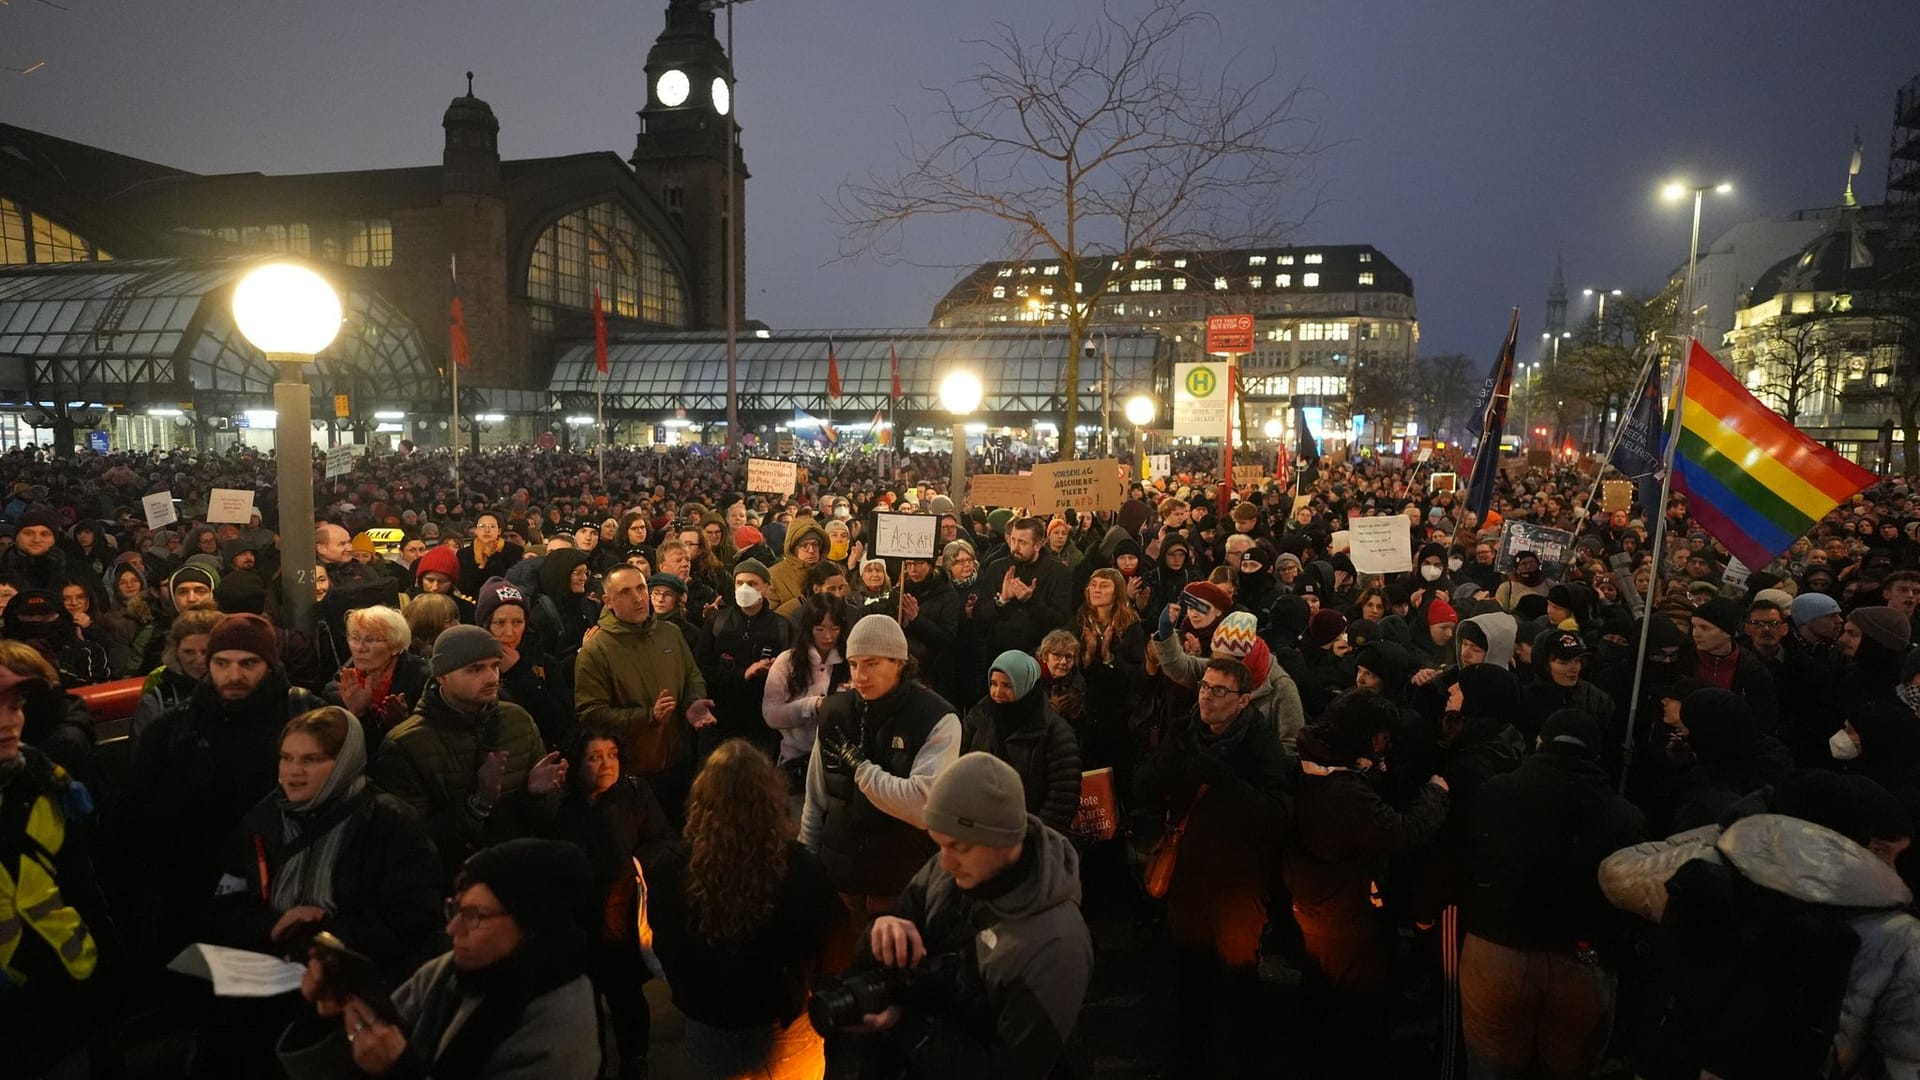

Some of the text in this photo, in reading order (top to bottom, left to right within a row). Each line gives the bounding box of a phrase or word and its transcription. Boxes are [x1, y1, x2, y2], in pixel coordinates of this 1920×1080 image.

[1194, 374, 1208, 391] H
[1053, 467, 1094, 478] VORSCHLAG
[1055, 478, 1099, 488] ABSCHIEBE-
[1061, 488, 1087, 496] TICKET
[1097, 818, 1111, 830] die
